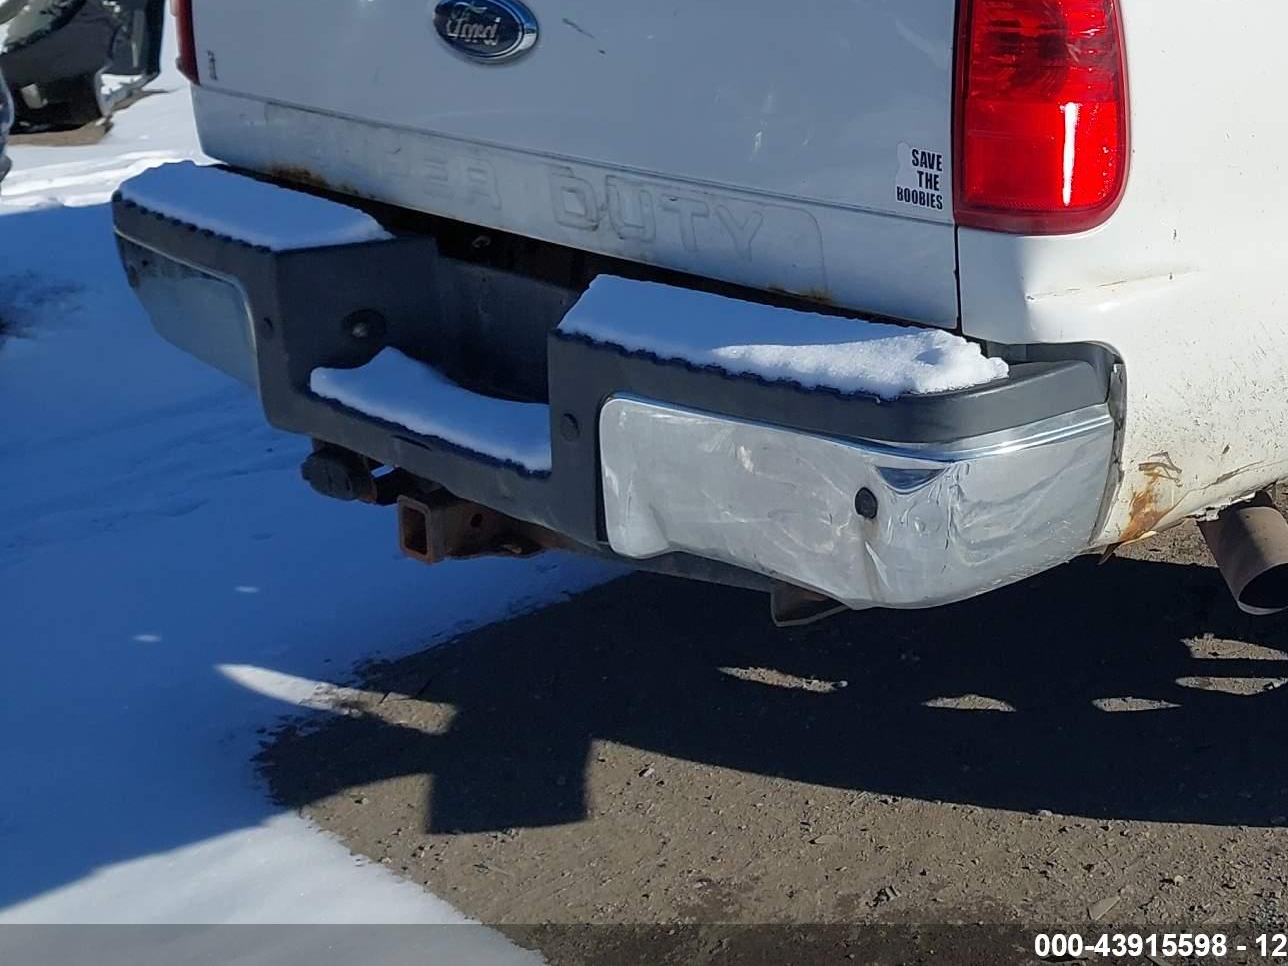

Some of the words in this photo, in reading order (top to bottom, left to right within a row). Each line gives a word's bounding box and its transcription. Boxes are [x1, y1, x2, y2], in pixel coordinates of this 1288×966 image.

[446, 1, 500, 46] Ford
[911, 148, 943, 172] SAVE
[917, 170, 940, 191] THE
[896, 186, 943, 210] BOOBIES
[544, 164, 765, 263] DUTY
